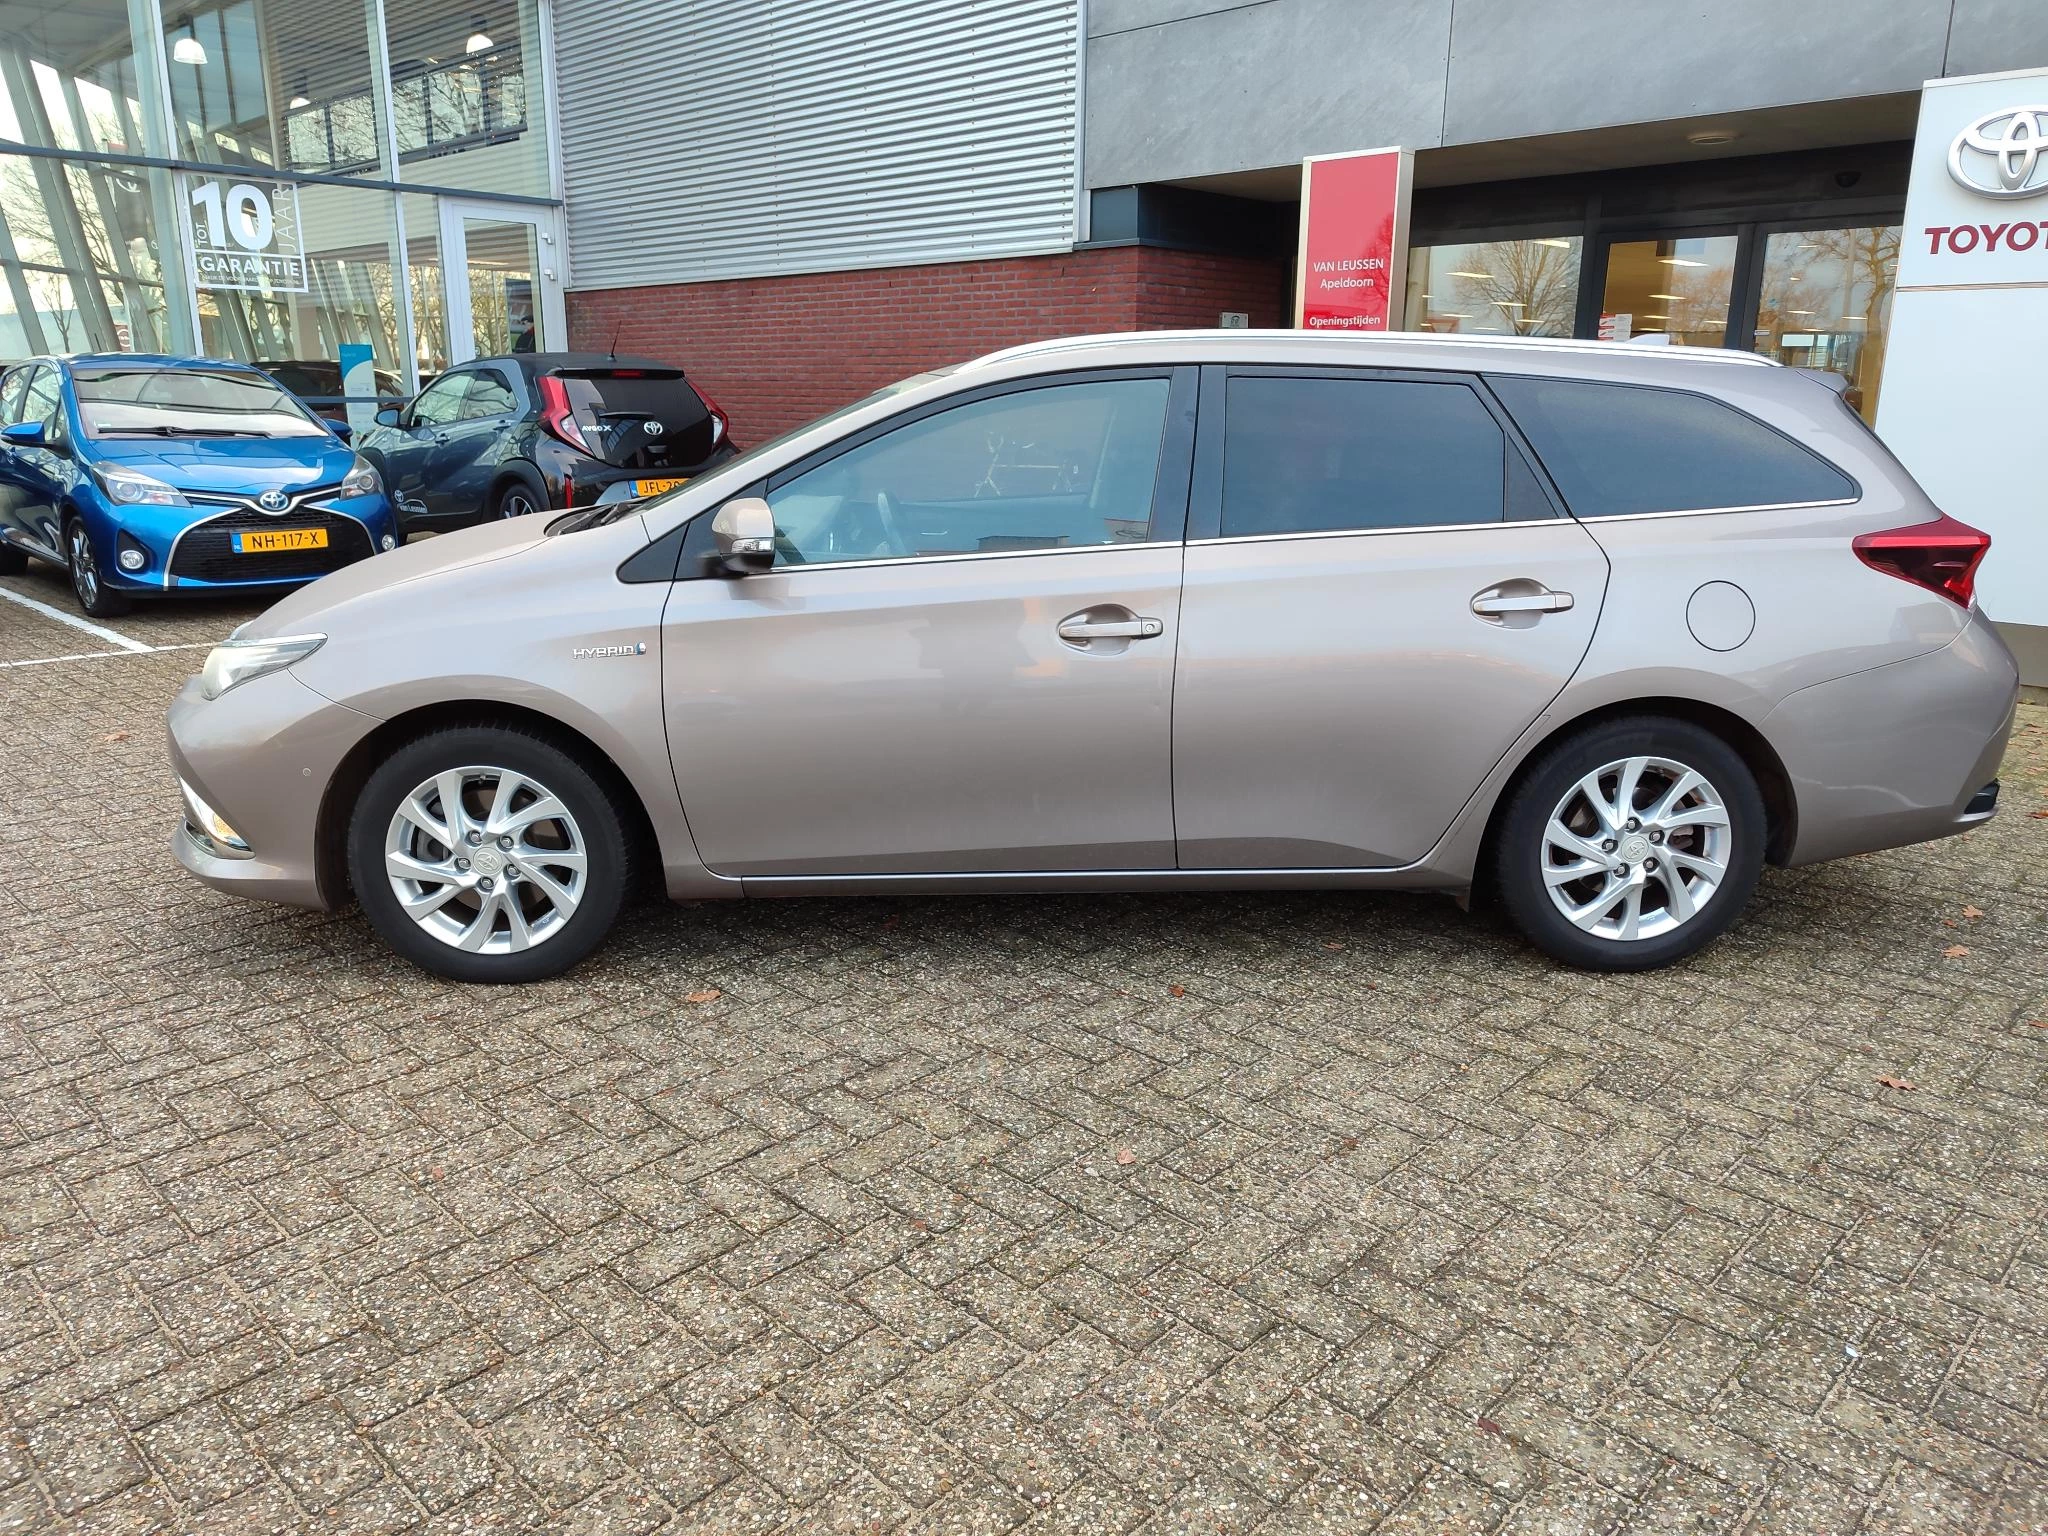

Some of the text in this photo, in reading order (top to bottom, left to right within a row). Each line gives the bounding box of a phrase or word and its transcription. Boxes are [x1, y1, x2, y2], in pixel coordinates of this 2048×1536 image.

[191, 181, 273, 250] 10
[272, 187, 297, 253] JAAR
[195, 222, 208, 245] TOT
[200, 256, 300, 277] GARANTIE
[1313, 258, 1384, 272] VAN LEUSSEN
[1320, 277, 1374, 291] Apeldoorn
[1309, 315, 1381, 328] Openingstijden
[252, 532, 319, 549] NH-117-X
[573, 645, 636, 659] HYBRID
